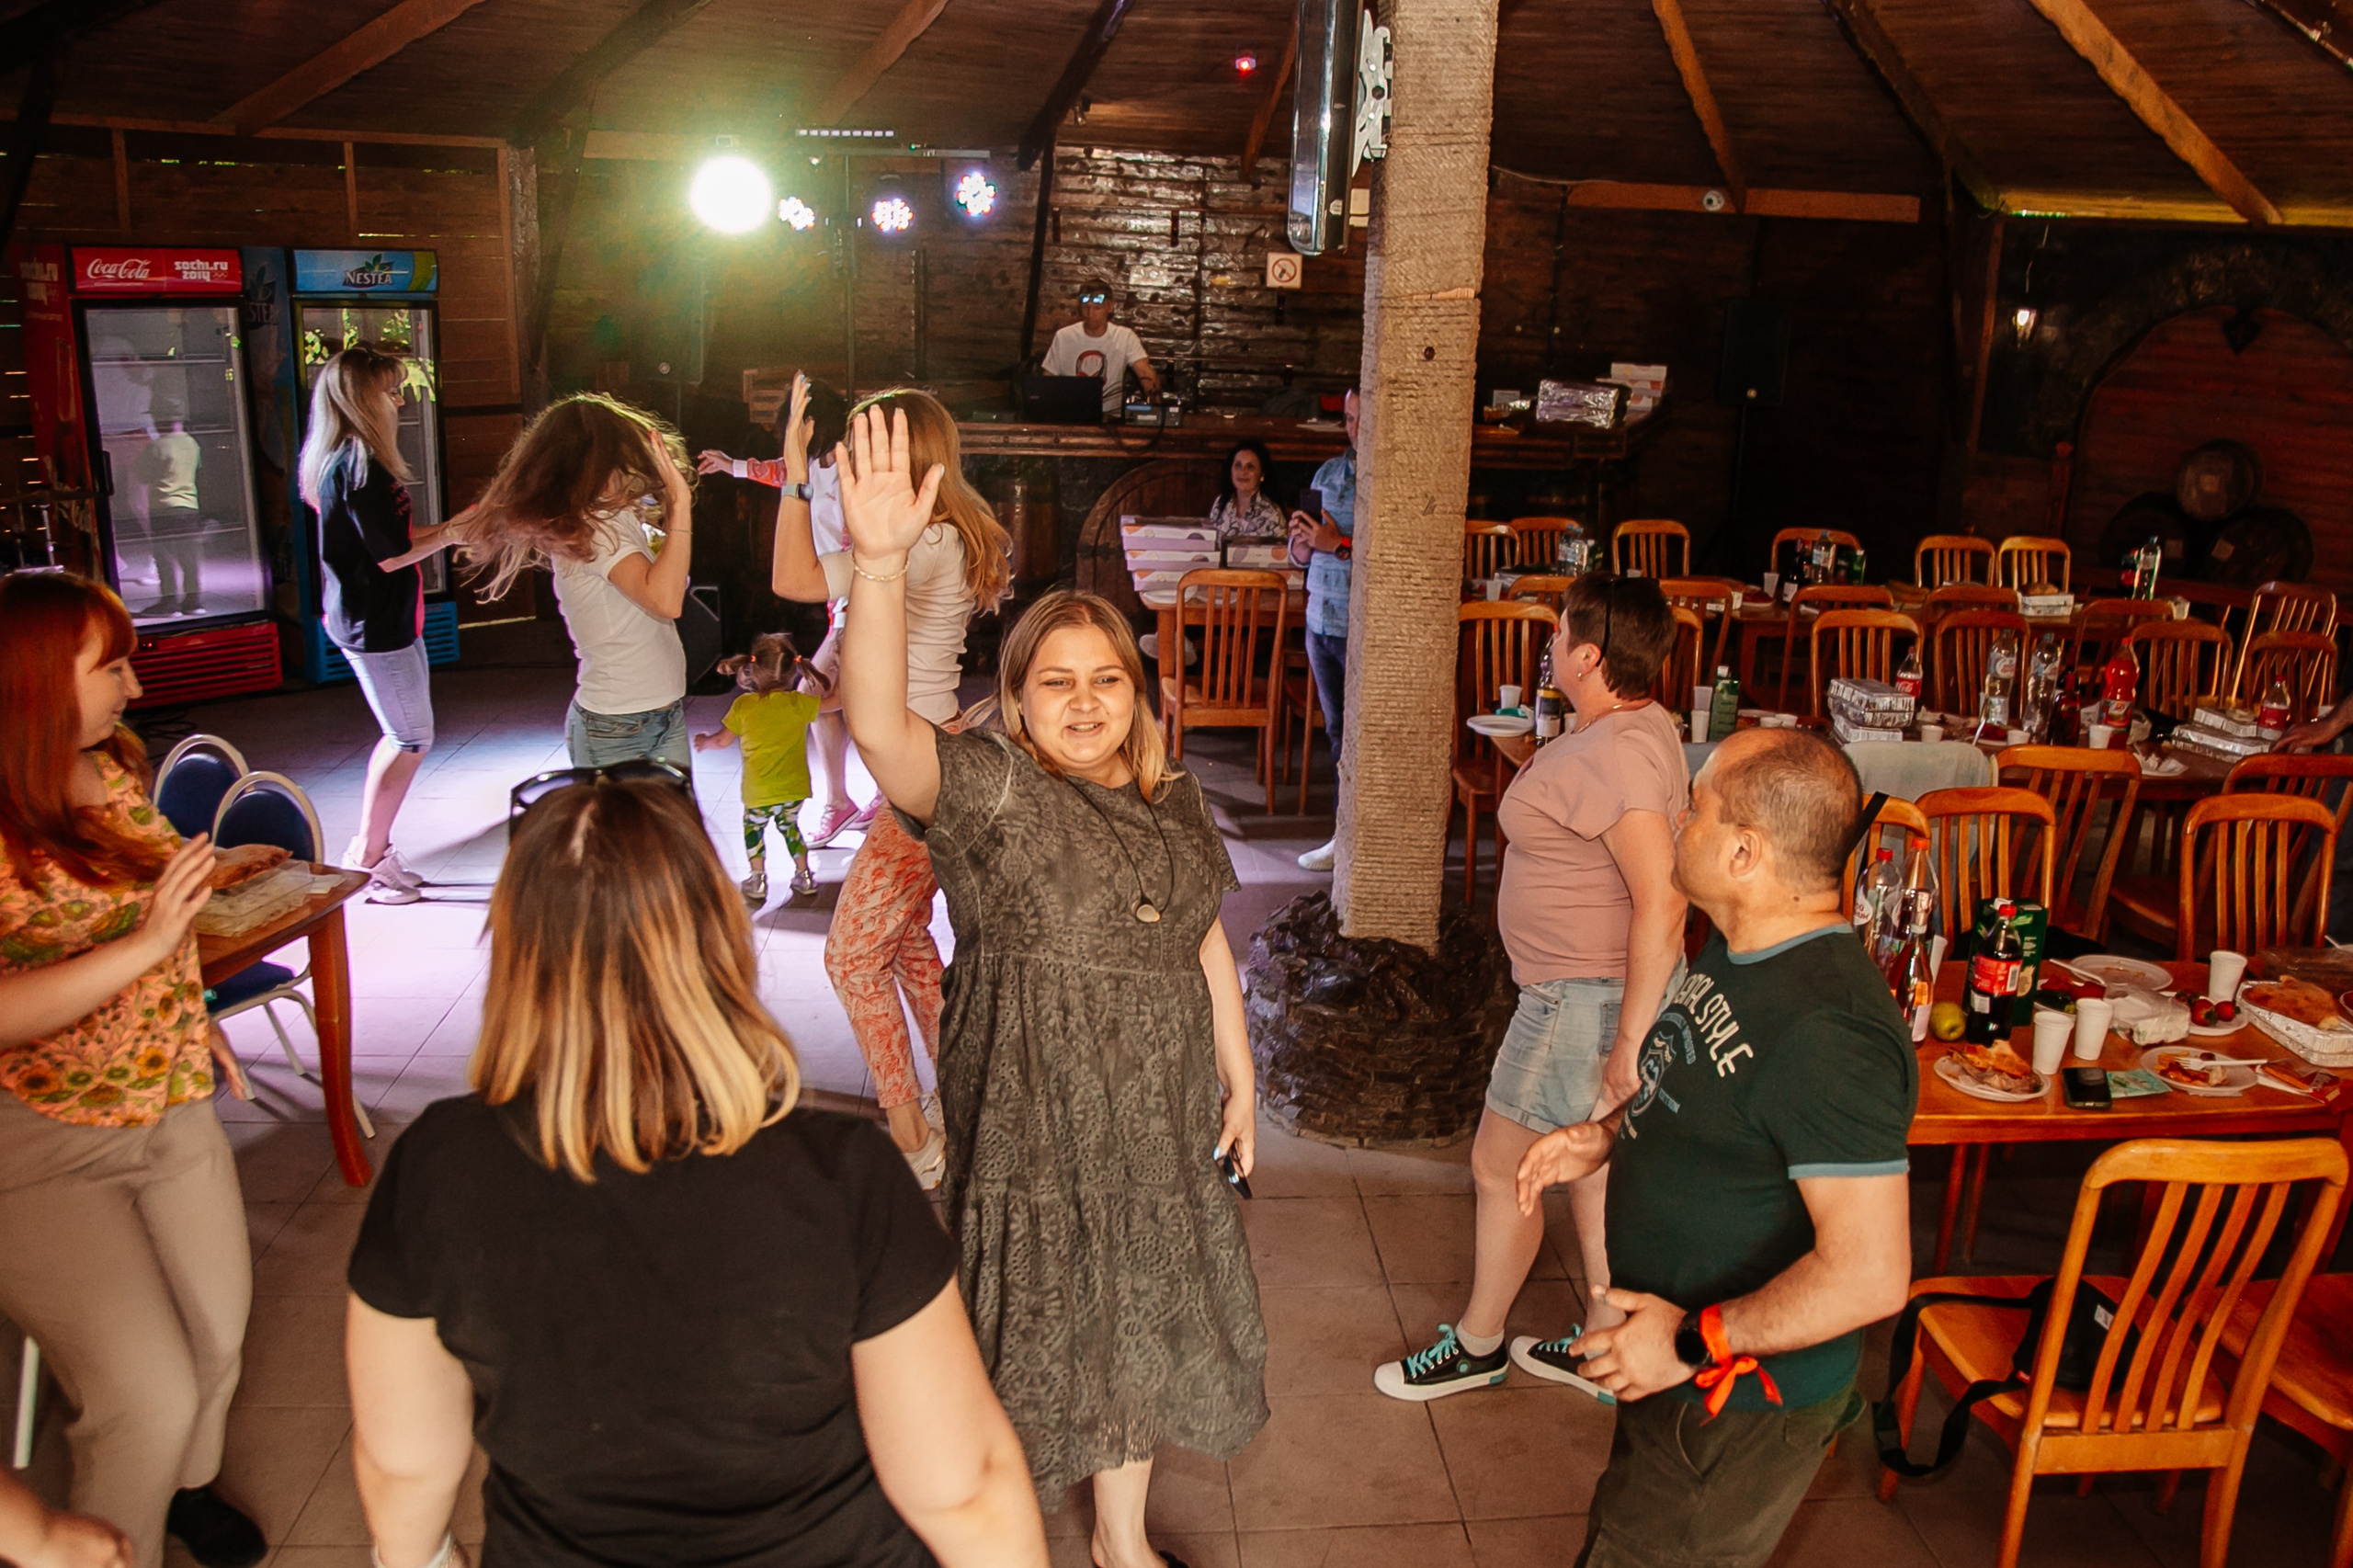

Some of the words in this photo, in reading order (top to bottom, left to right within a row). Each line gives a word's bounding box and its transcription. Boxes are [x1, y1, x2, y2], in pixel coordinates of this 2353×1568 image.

[87, 258, 152, 279] Coca-Cola
[174, 258, 229, 271] sochi.ru
[182, 270, 211, 282] 2014
[346, 270, 393, 285] NESTEA
[1694, 993, 1754, 1078] STYLE
